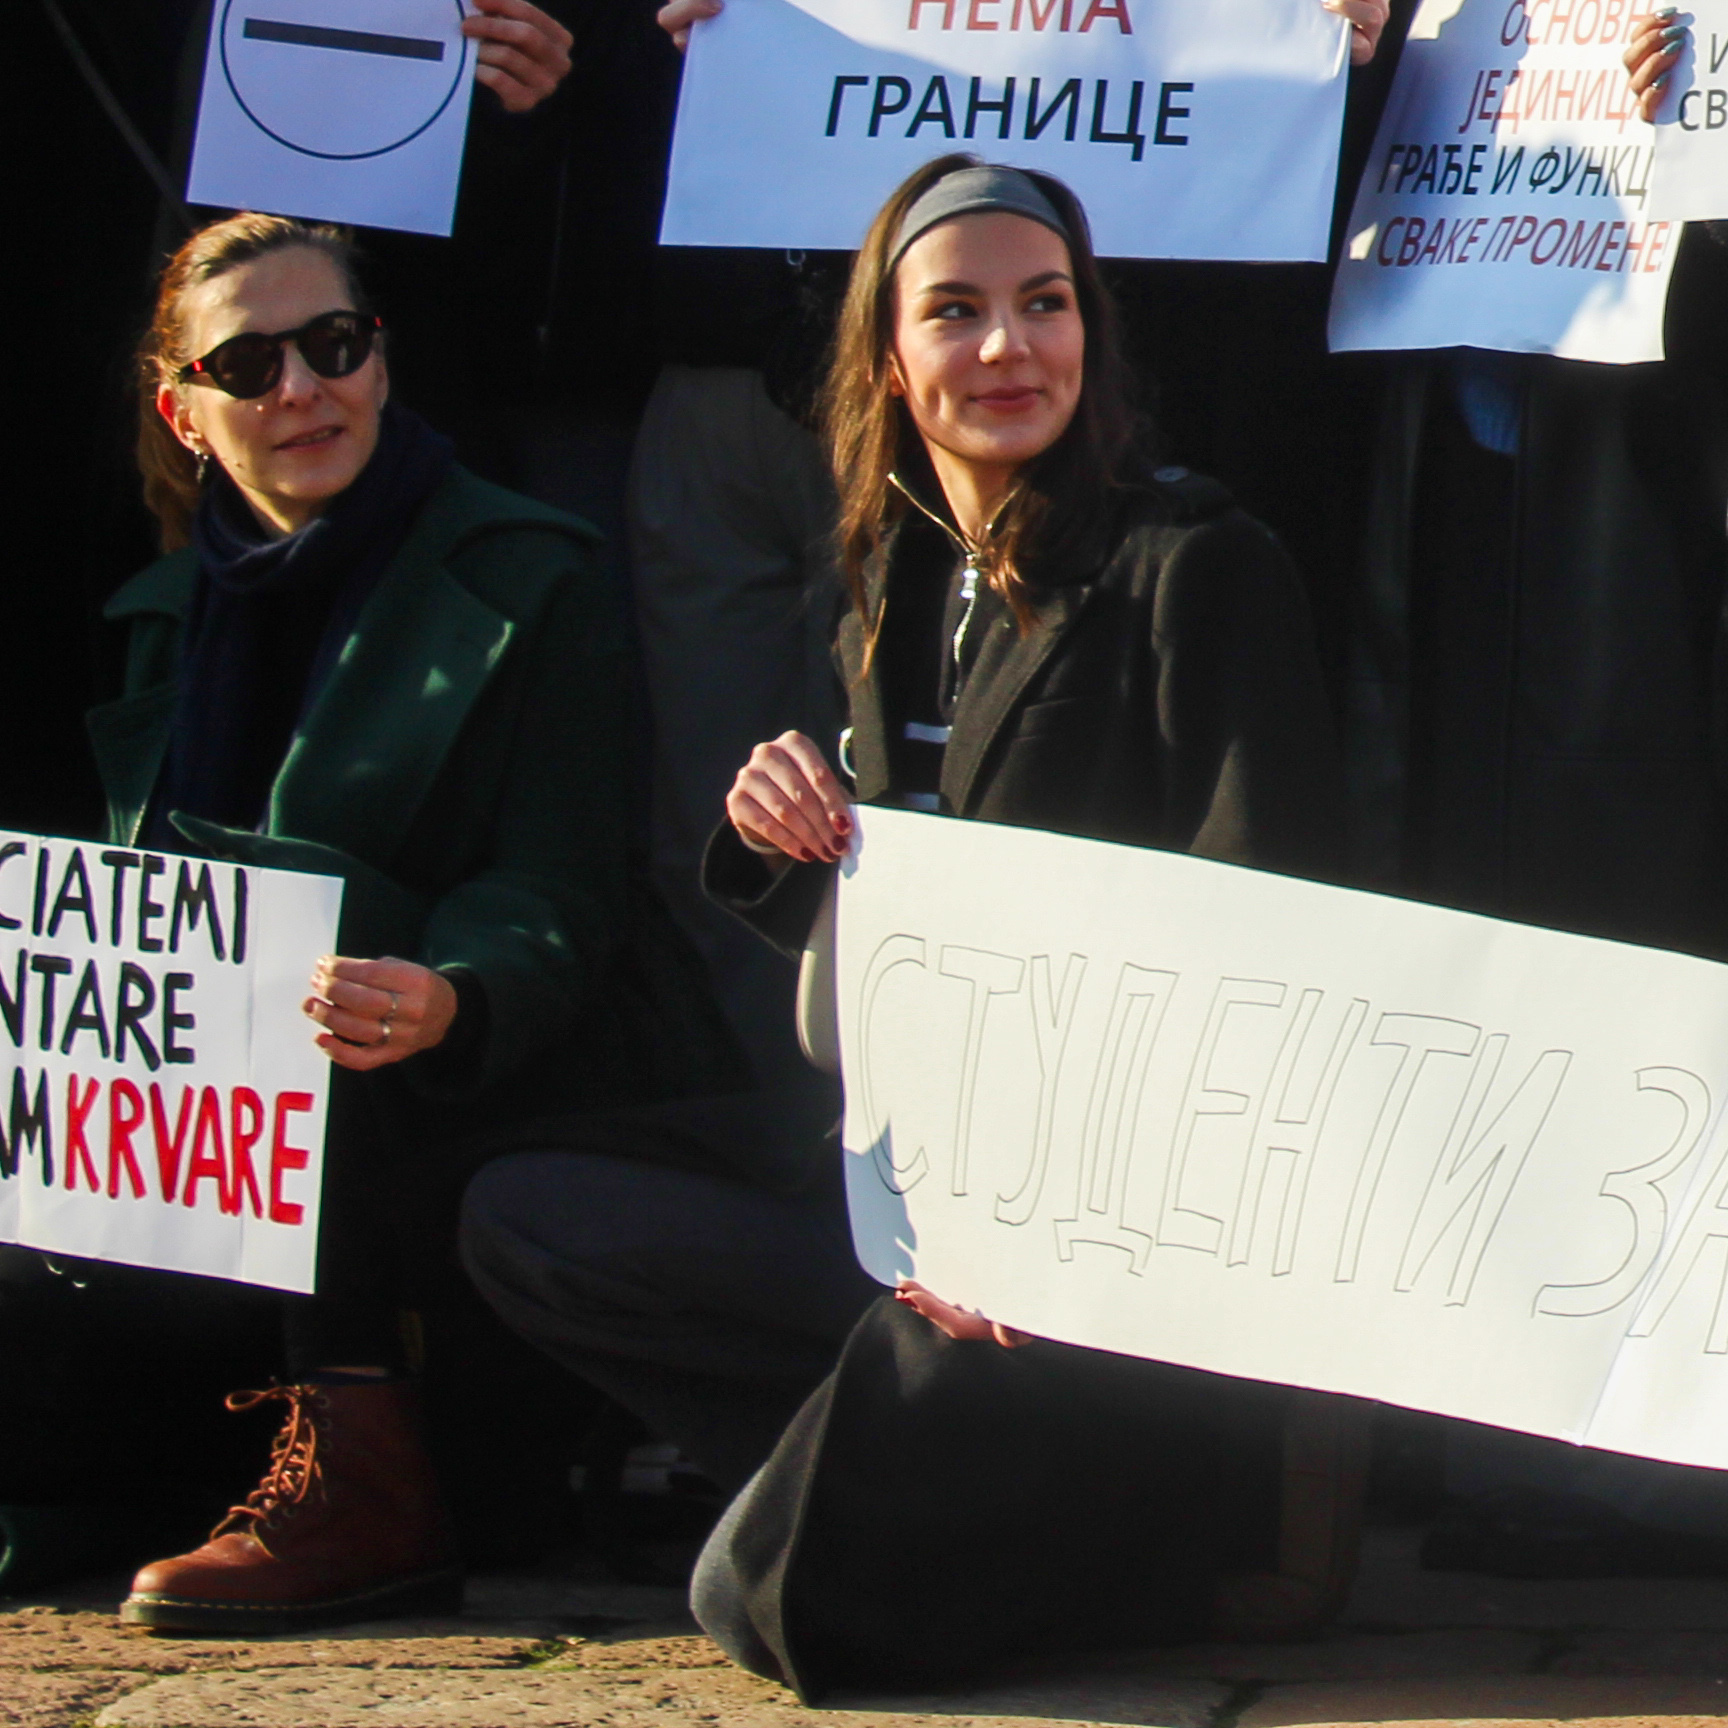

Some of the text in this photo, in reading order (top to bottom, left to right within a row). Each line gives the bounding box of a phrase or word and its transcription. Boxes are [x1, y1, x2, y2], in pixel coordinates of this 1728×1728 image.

[824, 74, 1195, 163] ГРАНИЦЕ
[1377, 144, 1488, 195] ГРАЂЕ
[1490, 145, 1524, 195] И
[1377, 216, 1491, 267] СВАКЕ
[64, 1073, 315, 1226] KRVARE
[857, 931, 1574, 1308] СТУДЕНТИ
